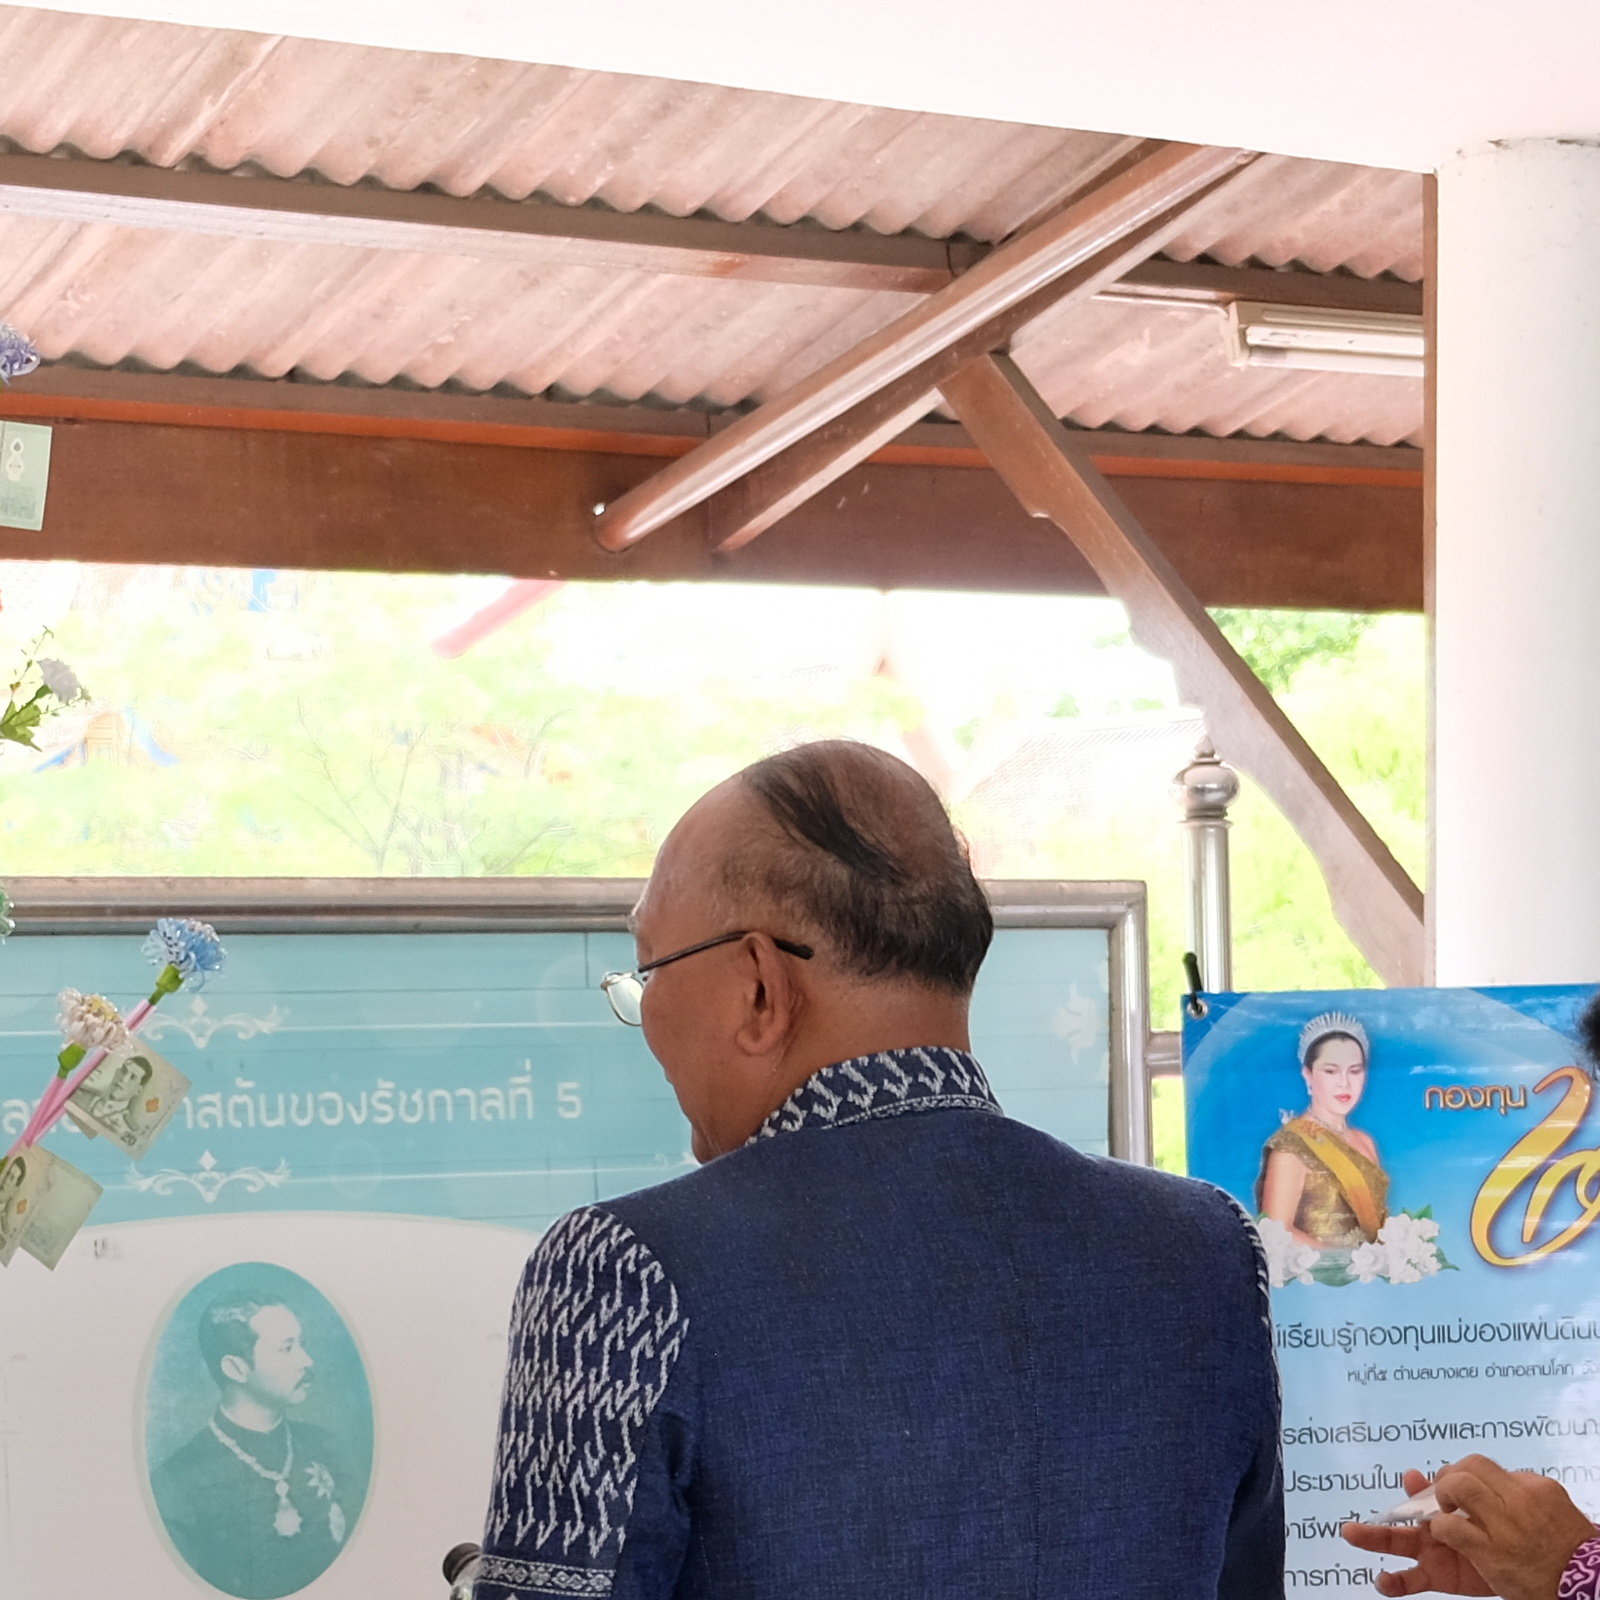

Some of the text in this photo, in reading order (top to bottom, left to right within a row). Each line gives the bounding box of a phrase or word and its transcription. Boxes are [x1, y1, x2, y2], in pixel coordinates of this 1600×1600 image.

[557, 1081, 583, 1120] 5
[1424, 1082, 1527, 1116] กองทุน
